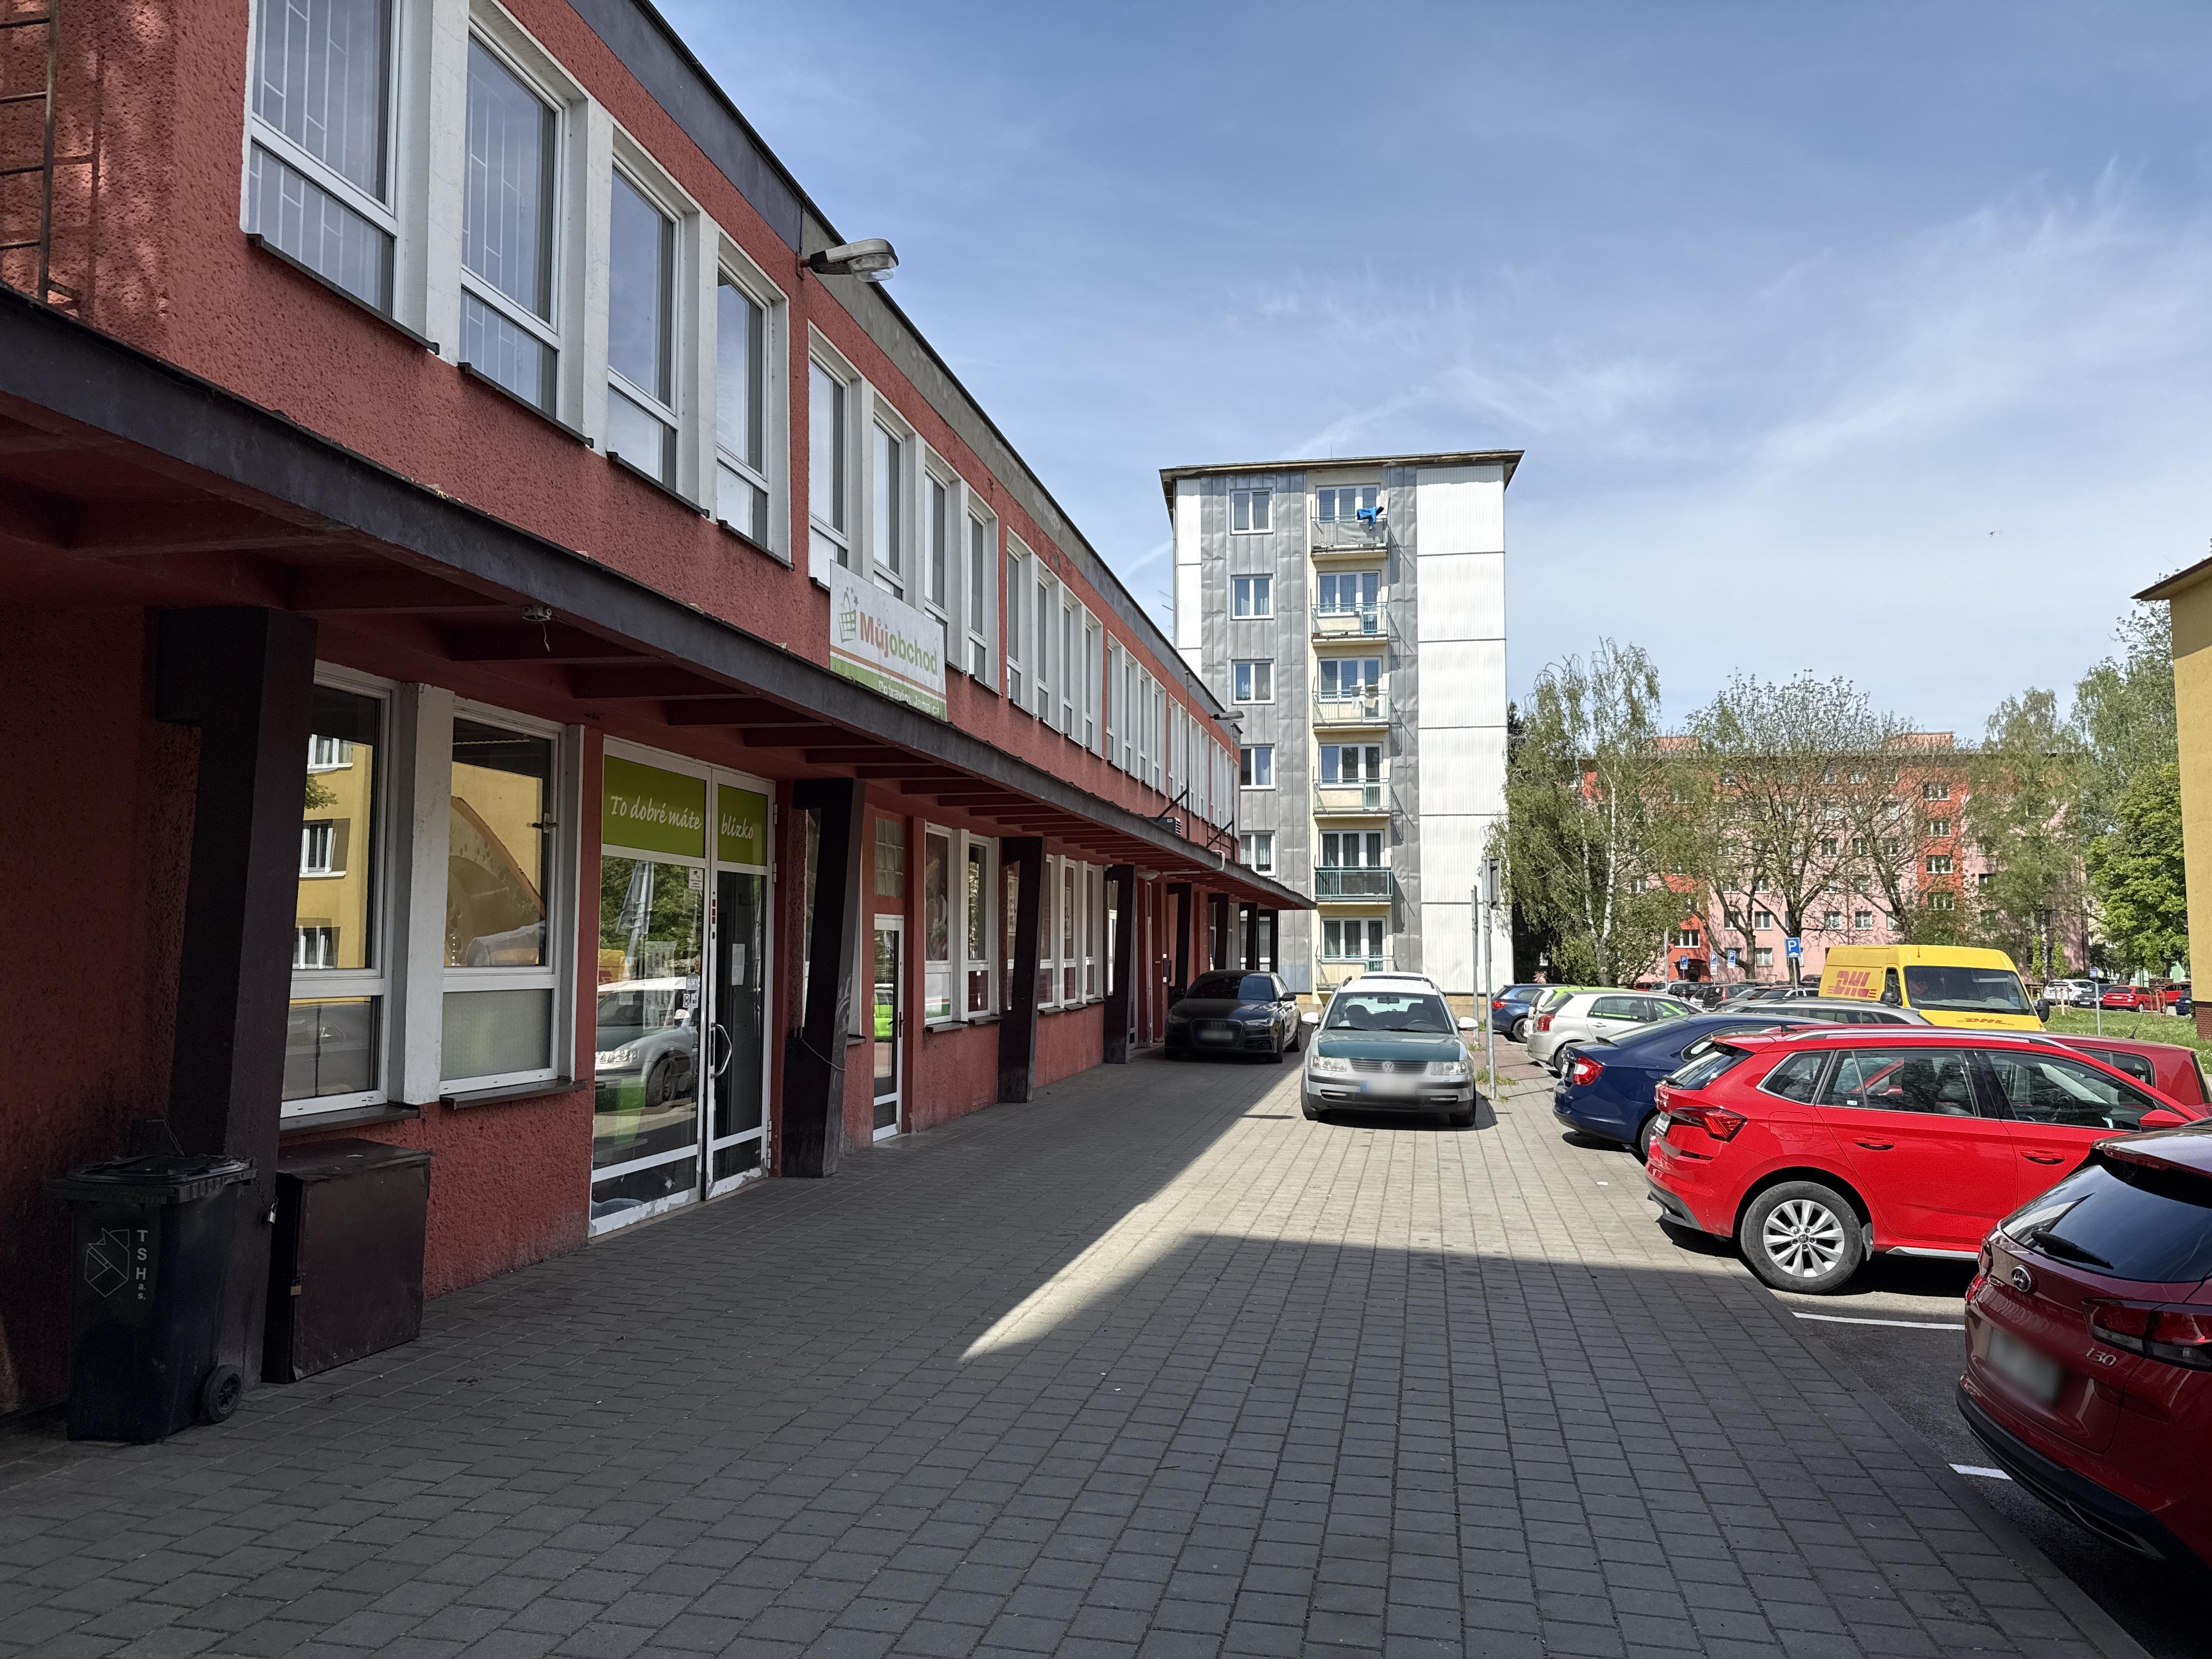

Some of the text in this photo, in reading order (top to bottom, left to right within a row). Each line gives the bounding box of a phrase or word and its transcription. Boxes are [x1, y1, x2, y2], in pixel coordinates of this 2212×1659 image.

[914, 696, 940, 716] Jamaica
[611, 795, 754, 839] To dobré máte blízko
[1787, 940, 1797, 952] P
[1833, 971, 1871, 998] DHL
[2085, 1347, 2117, 1366] i30
